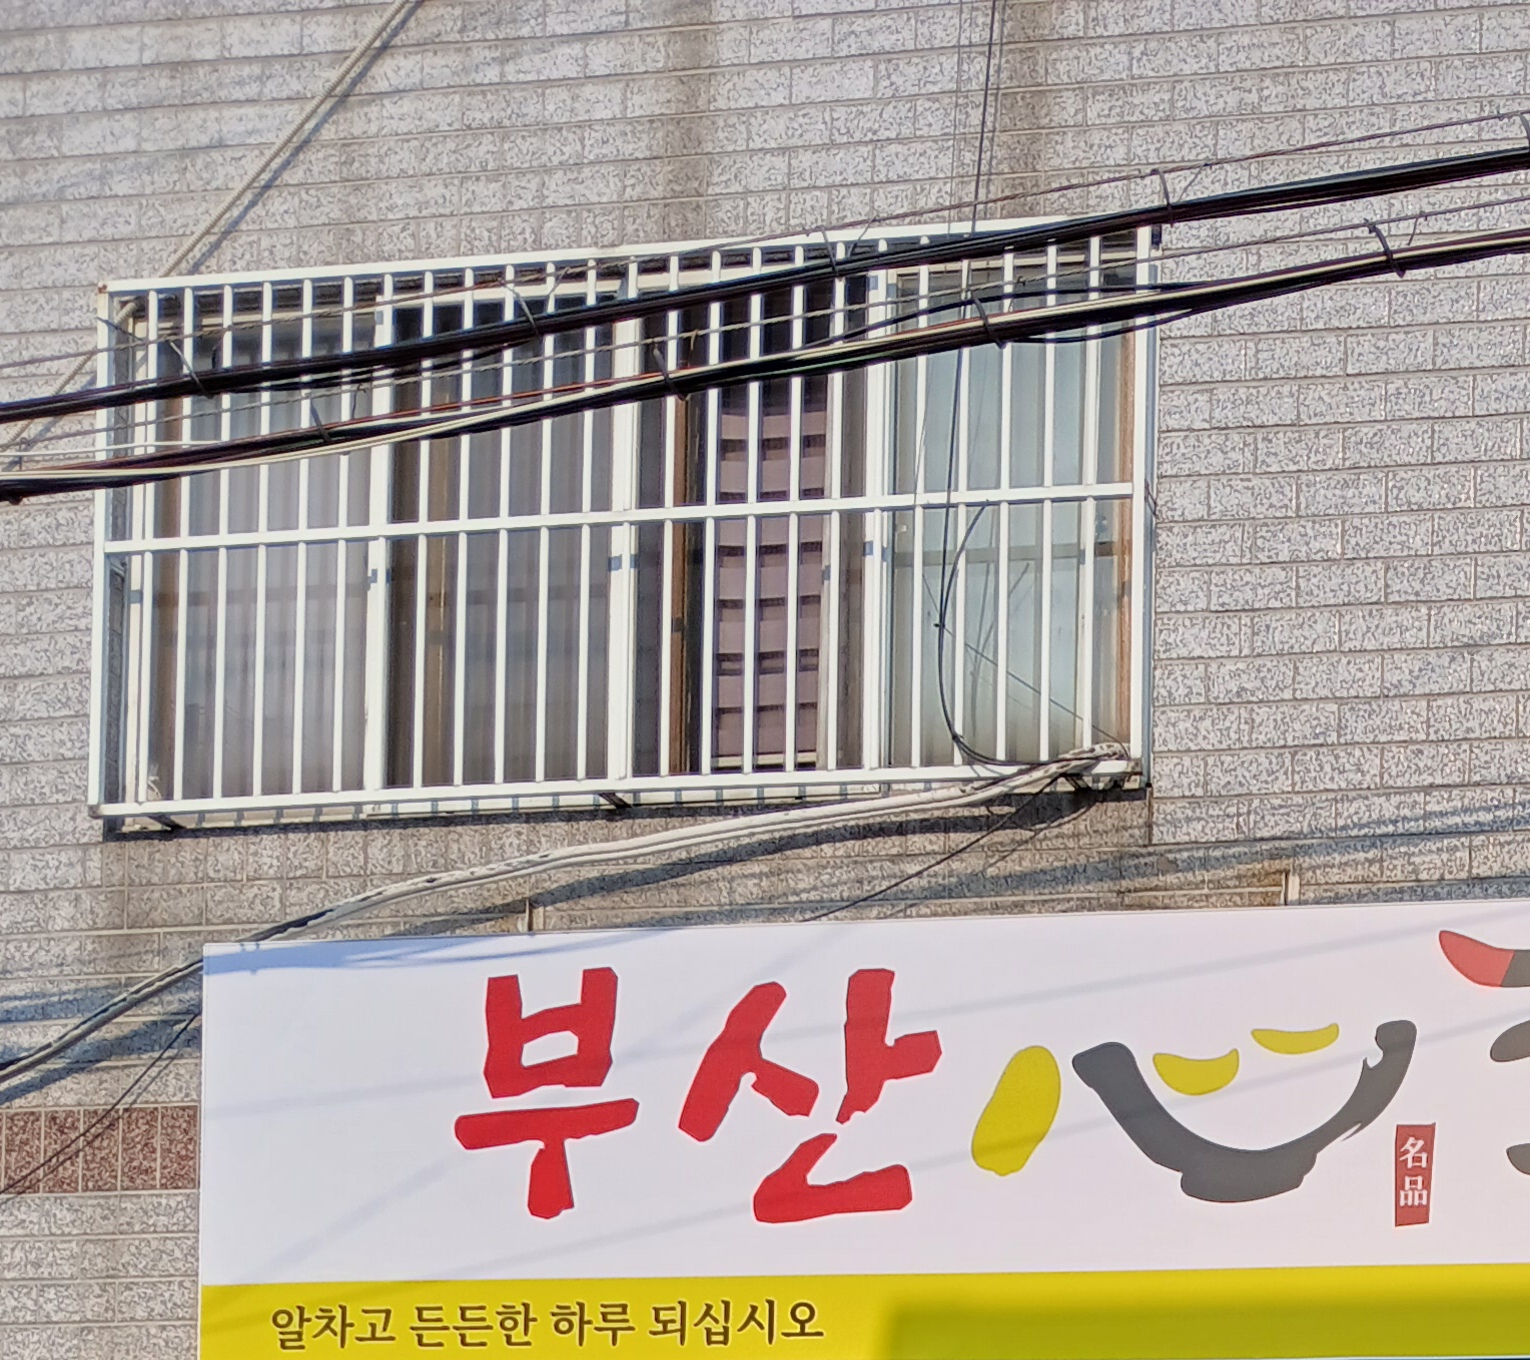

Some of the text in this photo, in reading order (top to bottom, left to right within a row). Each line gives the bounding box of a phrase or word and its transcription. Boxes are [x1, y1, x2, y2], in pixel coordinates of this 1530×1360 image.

[452, 965, 943, 1224] 부산
[1399, 1136, 1428, 1207] 名品
[271, 1299, 825, 1350] 알차고 든든한 하루 되십시오
